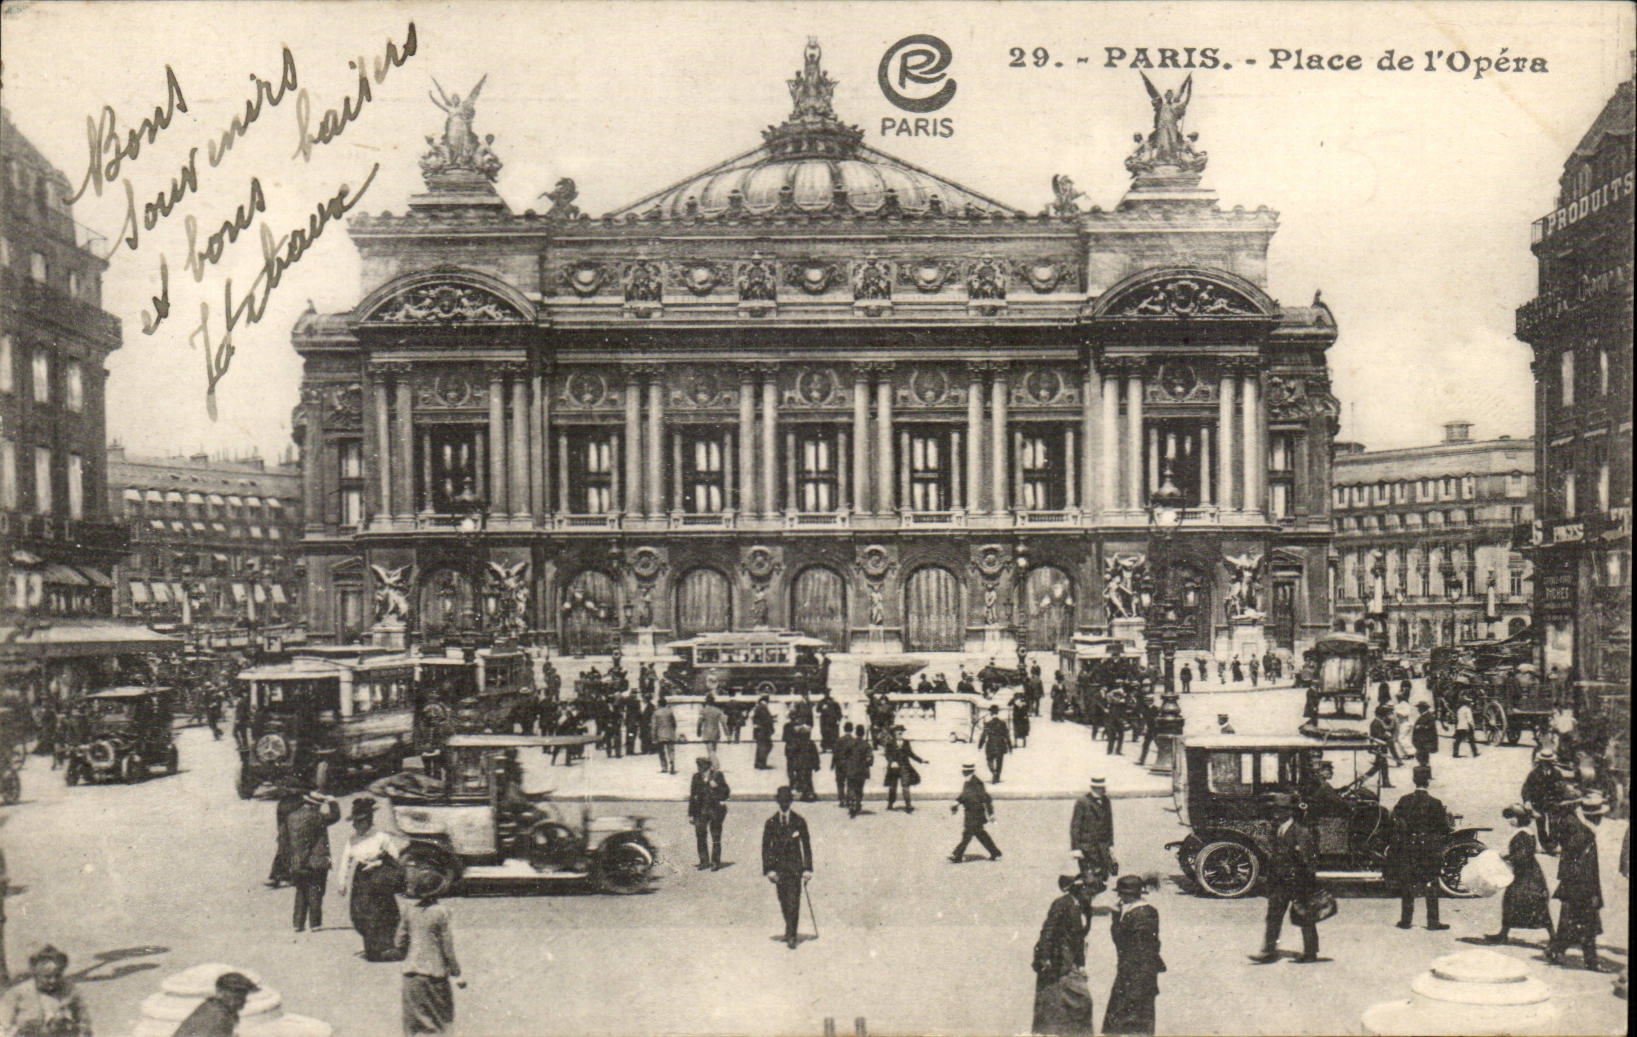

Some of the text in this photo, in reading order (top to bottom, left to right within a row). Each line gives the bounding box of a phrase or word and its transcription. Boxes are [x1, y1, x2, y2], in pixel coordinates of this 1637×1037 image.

[62, 63, 187, 206] Bons
[1546, 170, 1634, 236] PRODUITS
[142, 252, 170, 336] et
[184, 176, 266, 283] bons
